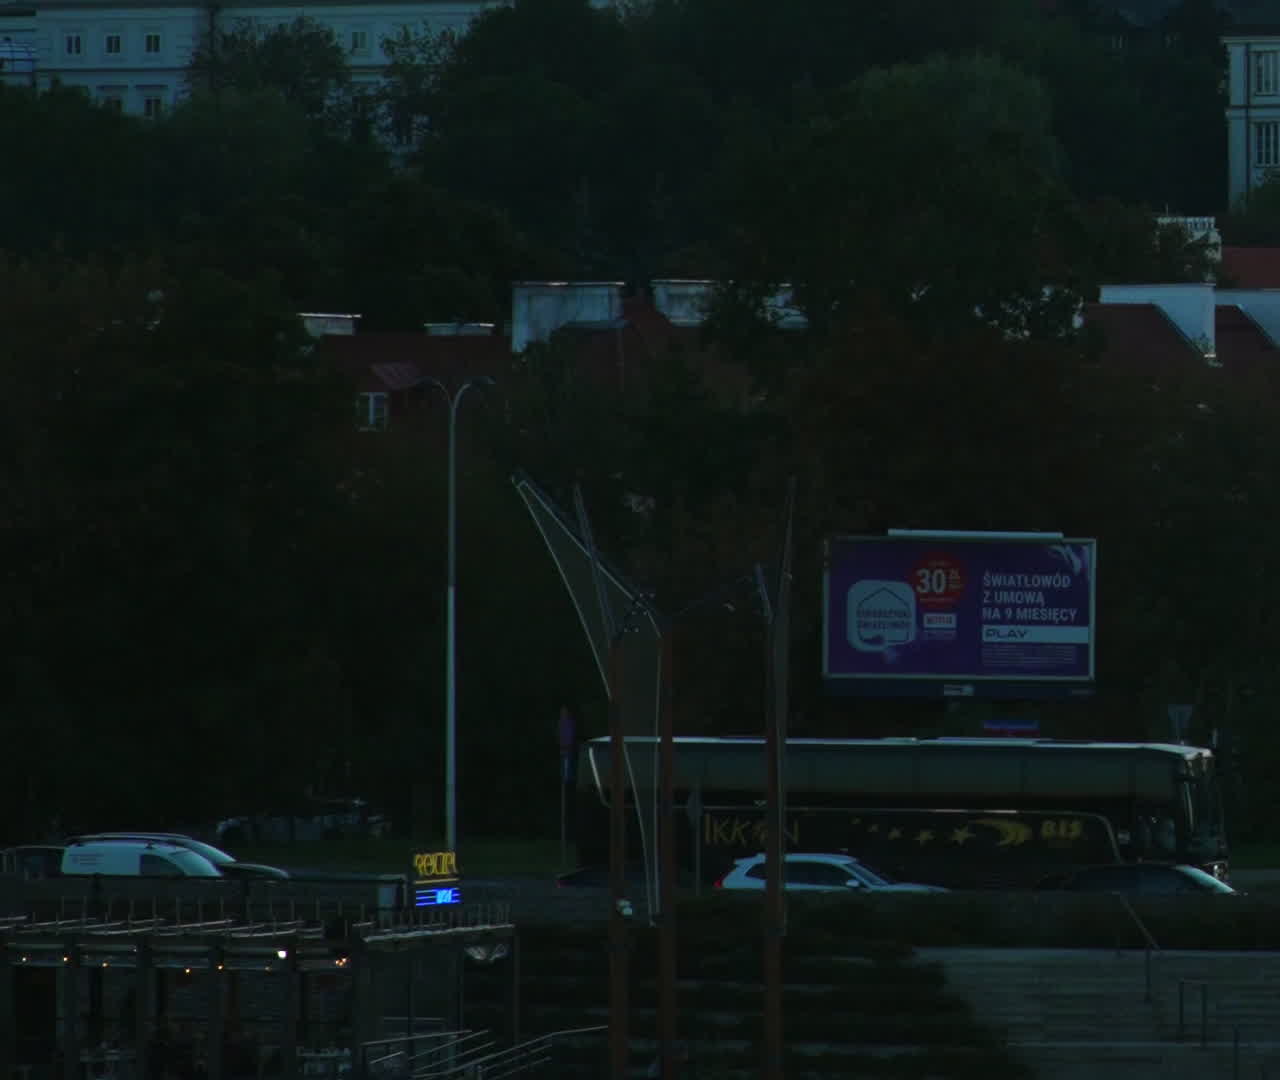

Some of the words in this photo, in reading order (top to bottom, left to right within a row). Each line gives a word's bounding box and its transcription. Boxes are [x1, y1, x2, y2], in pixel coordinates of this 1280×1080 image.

[915, 568, 946, 594] 30
[983, 569, 1072, 588] ŚWIATŁOWÓD
[983, 591, 992, 604] Z
[994, 591, 1046, 607] UMOWĄ
[982, 607, 1001, 621] NA
[1005, 607, 1013, 621] 9
[1016, 607, 1078, 625] MIESIĘCY
[985, 628, 1030, 639] PLAY
